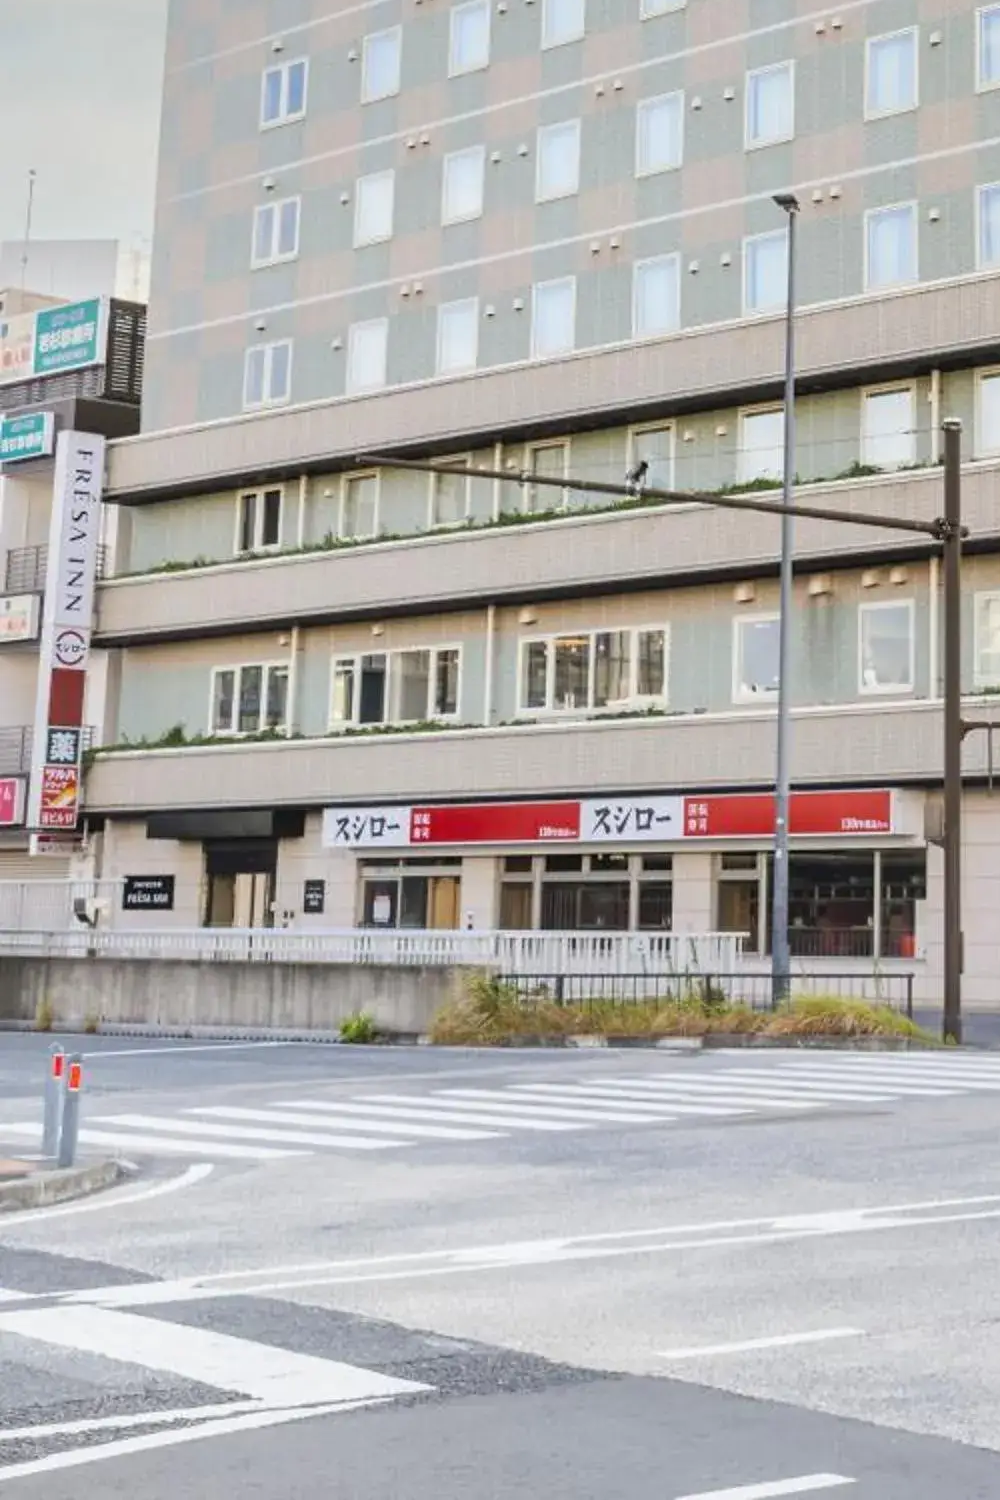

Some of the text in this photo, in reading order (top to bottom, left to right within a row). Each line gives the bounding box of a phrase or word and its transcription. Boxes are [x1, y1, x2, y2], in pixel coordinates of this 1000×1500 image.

[64, 558, 86, 612] INN
[335, 814, 400, 842] スシロー
[591, 806, 673, 835] スシロー
